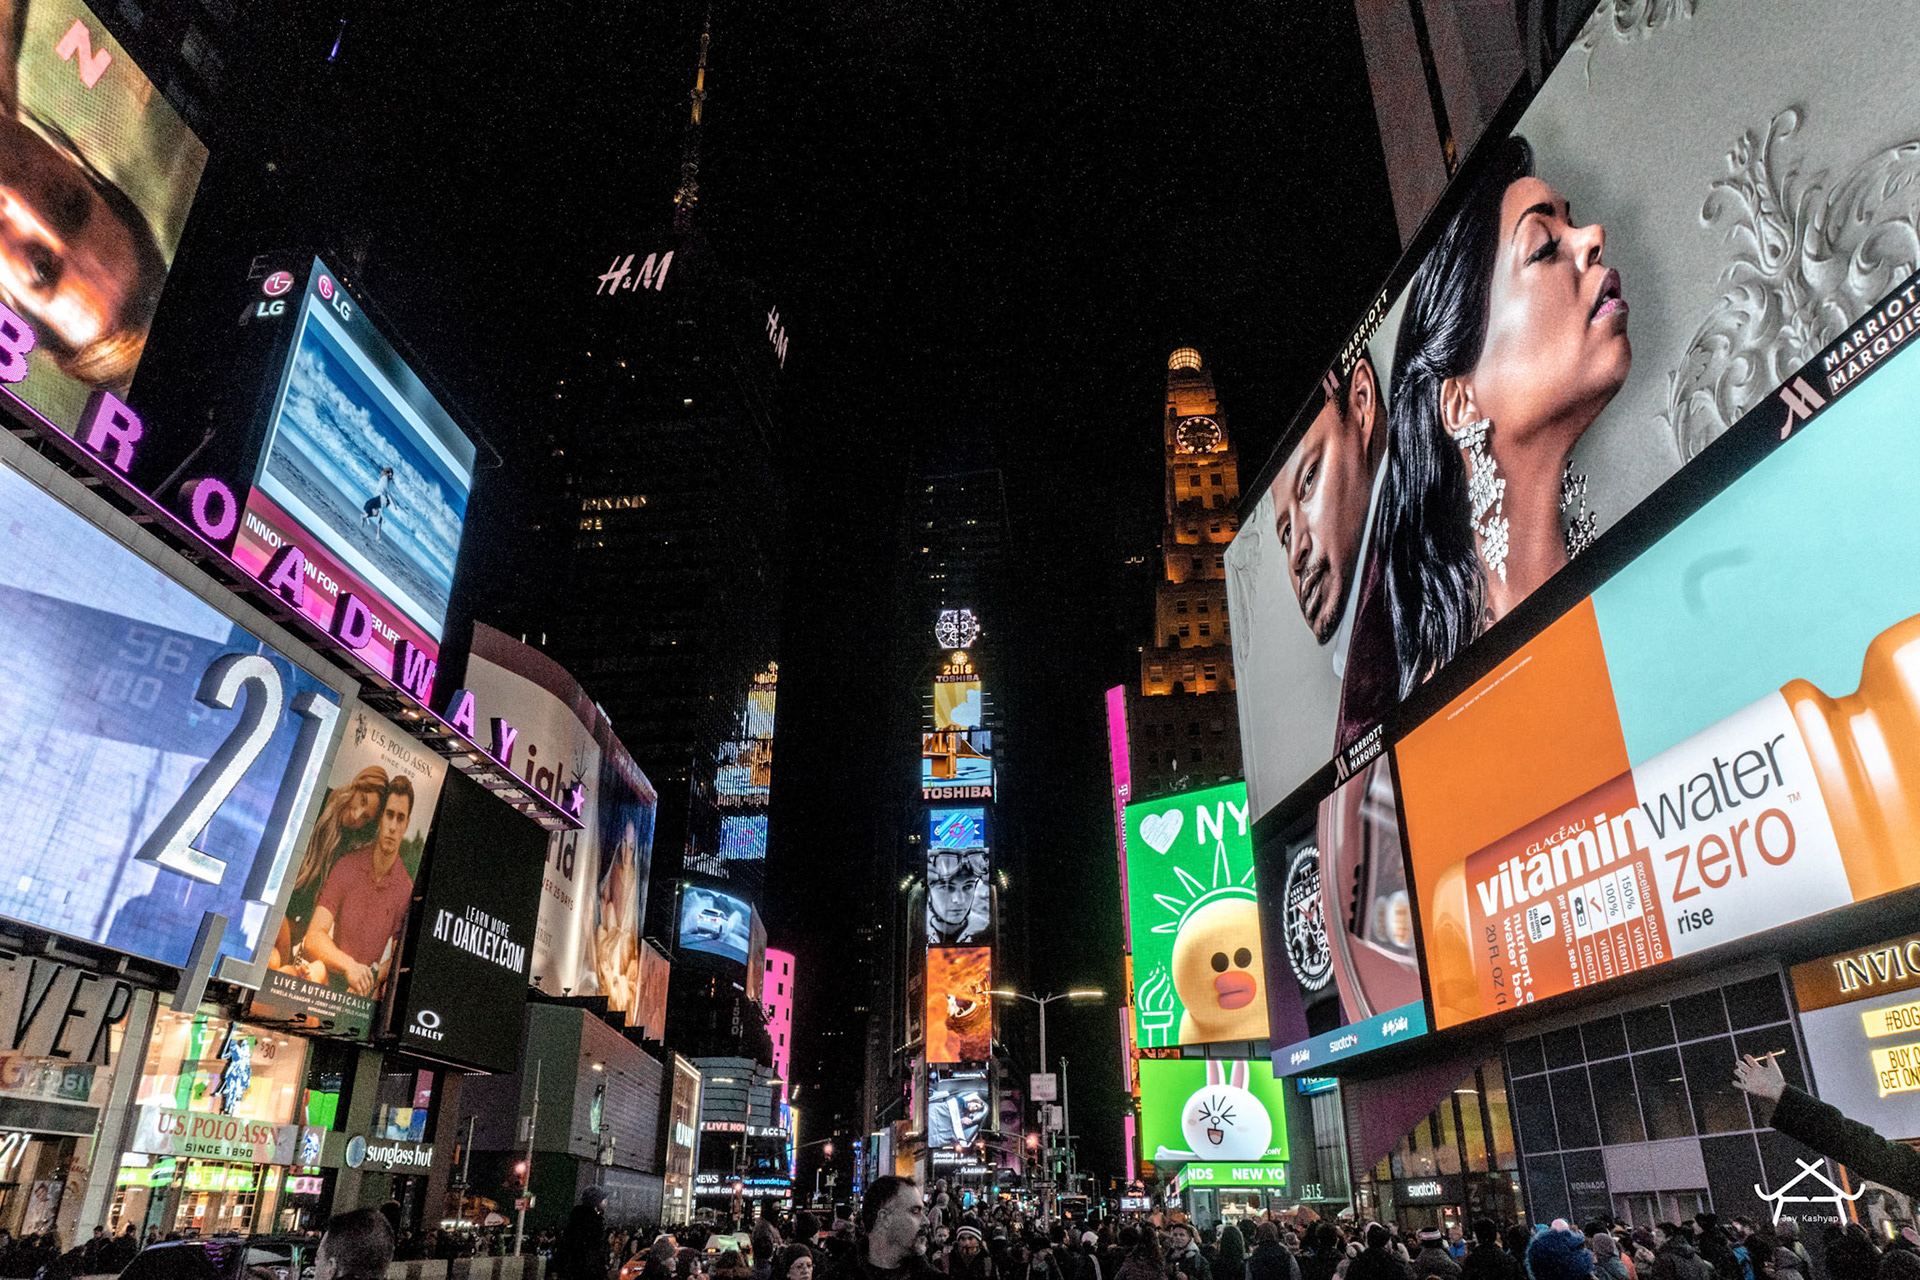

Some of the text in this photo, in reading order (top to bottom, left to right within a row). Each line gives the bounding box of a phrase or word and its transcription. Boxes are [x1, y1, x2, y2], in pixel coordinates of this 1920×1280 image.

[597, 251, 674, 295] H&M
[257, 301, 285, 318] LG
[332, 290, 351, 321] LG
[1341, 289, 1388, 365] MARRIOTT
[1823, 279, 1920, 371] MARRIOT
[317, 571, 340, 597] FOR
[936, 674, 980, 683] TOSHIBA
[943, 664, 972, 675] 2018
[371, 729, 433, 779] U.S. POLO ASSN.
[1349, 724, 1382, 758] MARRIOTT
[381, 753, 399, 769] SINCE
[1351, 741, 1380, 770] MARQUIS
[137, 652, 342, 906] 21
[922, 785, 992, 800] TOSHIBA
[1526, 820, 1586, 856] GLACÉAU
[1665, 808, 1796, 903] zero
[1557, 894, 1567, 910] per
[1605, 883, 1618, 917] 100%
[1622, 875, 1636, 910] 150%
[466, 904, 490, 929] LEARN
[491, 917, 510, 939] MORE
[1636, 861, 1664, 960] excellent source
[1677, 908, 1714, 934] rise
[433, 909, 525, 974] AT OAKLEY.COM
[1486, 924, 1497, 943] 20
[1504, 917, 1518, 967] water
[1561, 911, 1573, 948] bottle,
[1489, 945, 1500, 965] FL
[1513, 913, 1534, 986] nutrient
[1568, 948, 1577, 970] see
[1492, 967, 1504, 989] OZ
[274, 976, 371, 1010] LIVE AUTHENTICALLY
[409, 1024, 444, 1042] OAKLEY
[1329, 1034, 1353, 1053] swatch
[260, 1041, 276, 1060] $30
[1888, 1047, 1911, 1069] BUY
[1880, 1066, 1920, 1090] GET ON
[157, 1112, 282, 1147] U.S. POLO ASSN.
[706, 1122, 729, 1131] LIVE
[185, 1143, 253, 1158] SINCE 1890
[366, 1142, 433, 1171] sunglass hut
[1232, 1168, 1263, 1180] NEW
[1266, 1168, 1284, 1180] YO
[1571, 1181, 1606, 1191] VORNADO
[1301, 1184, 1322, 1198] 1515
[1408, 1182, 1437, 1197] swatch
